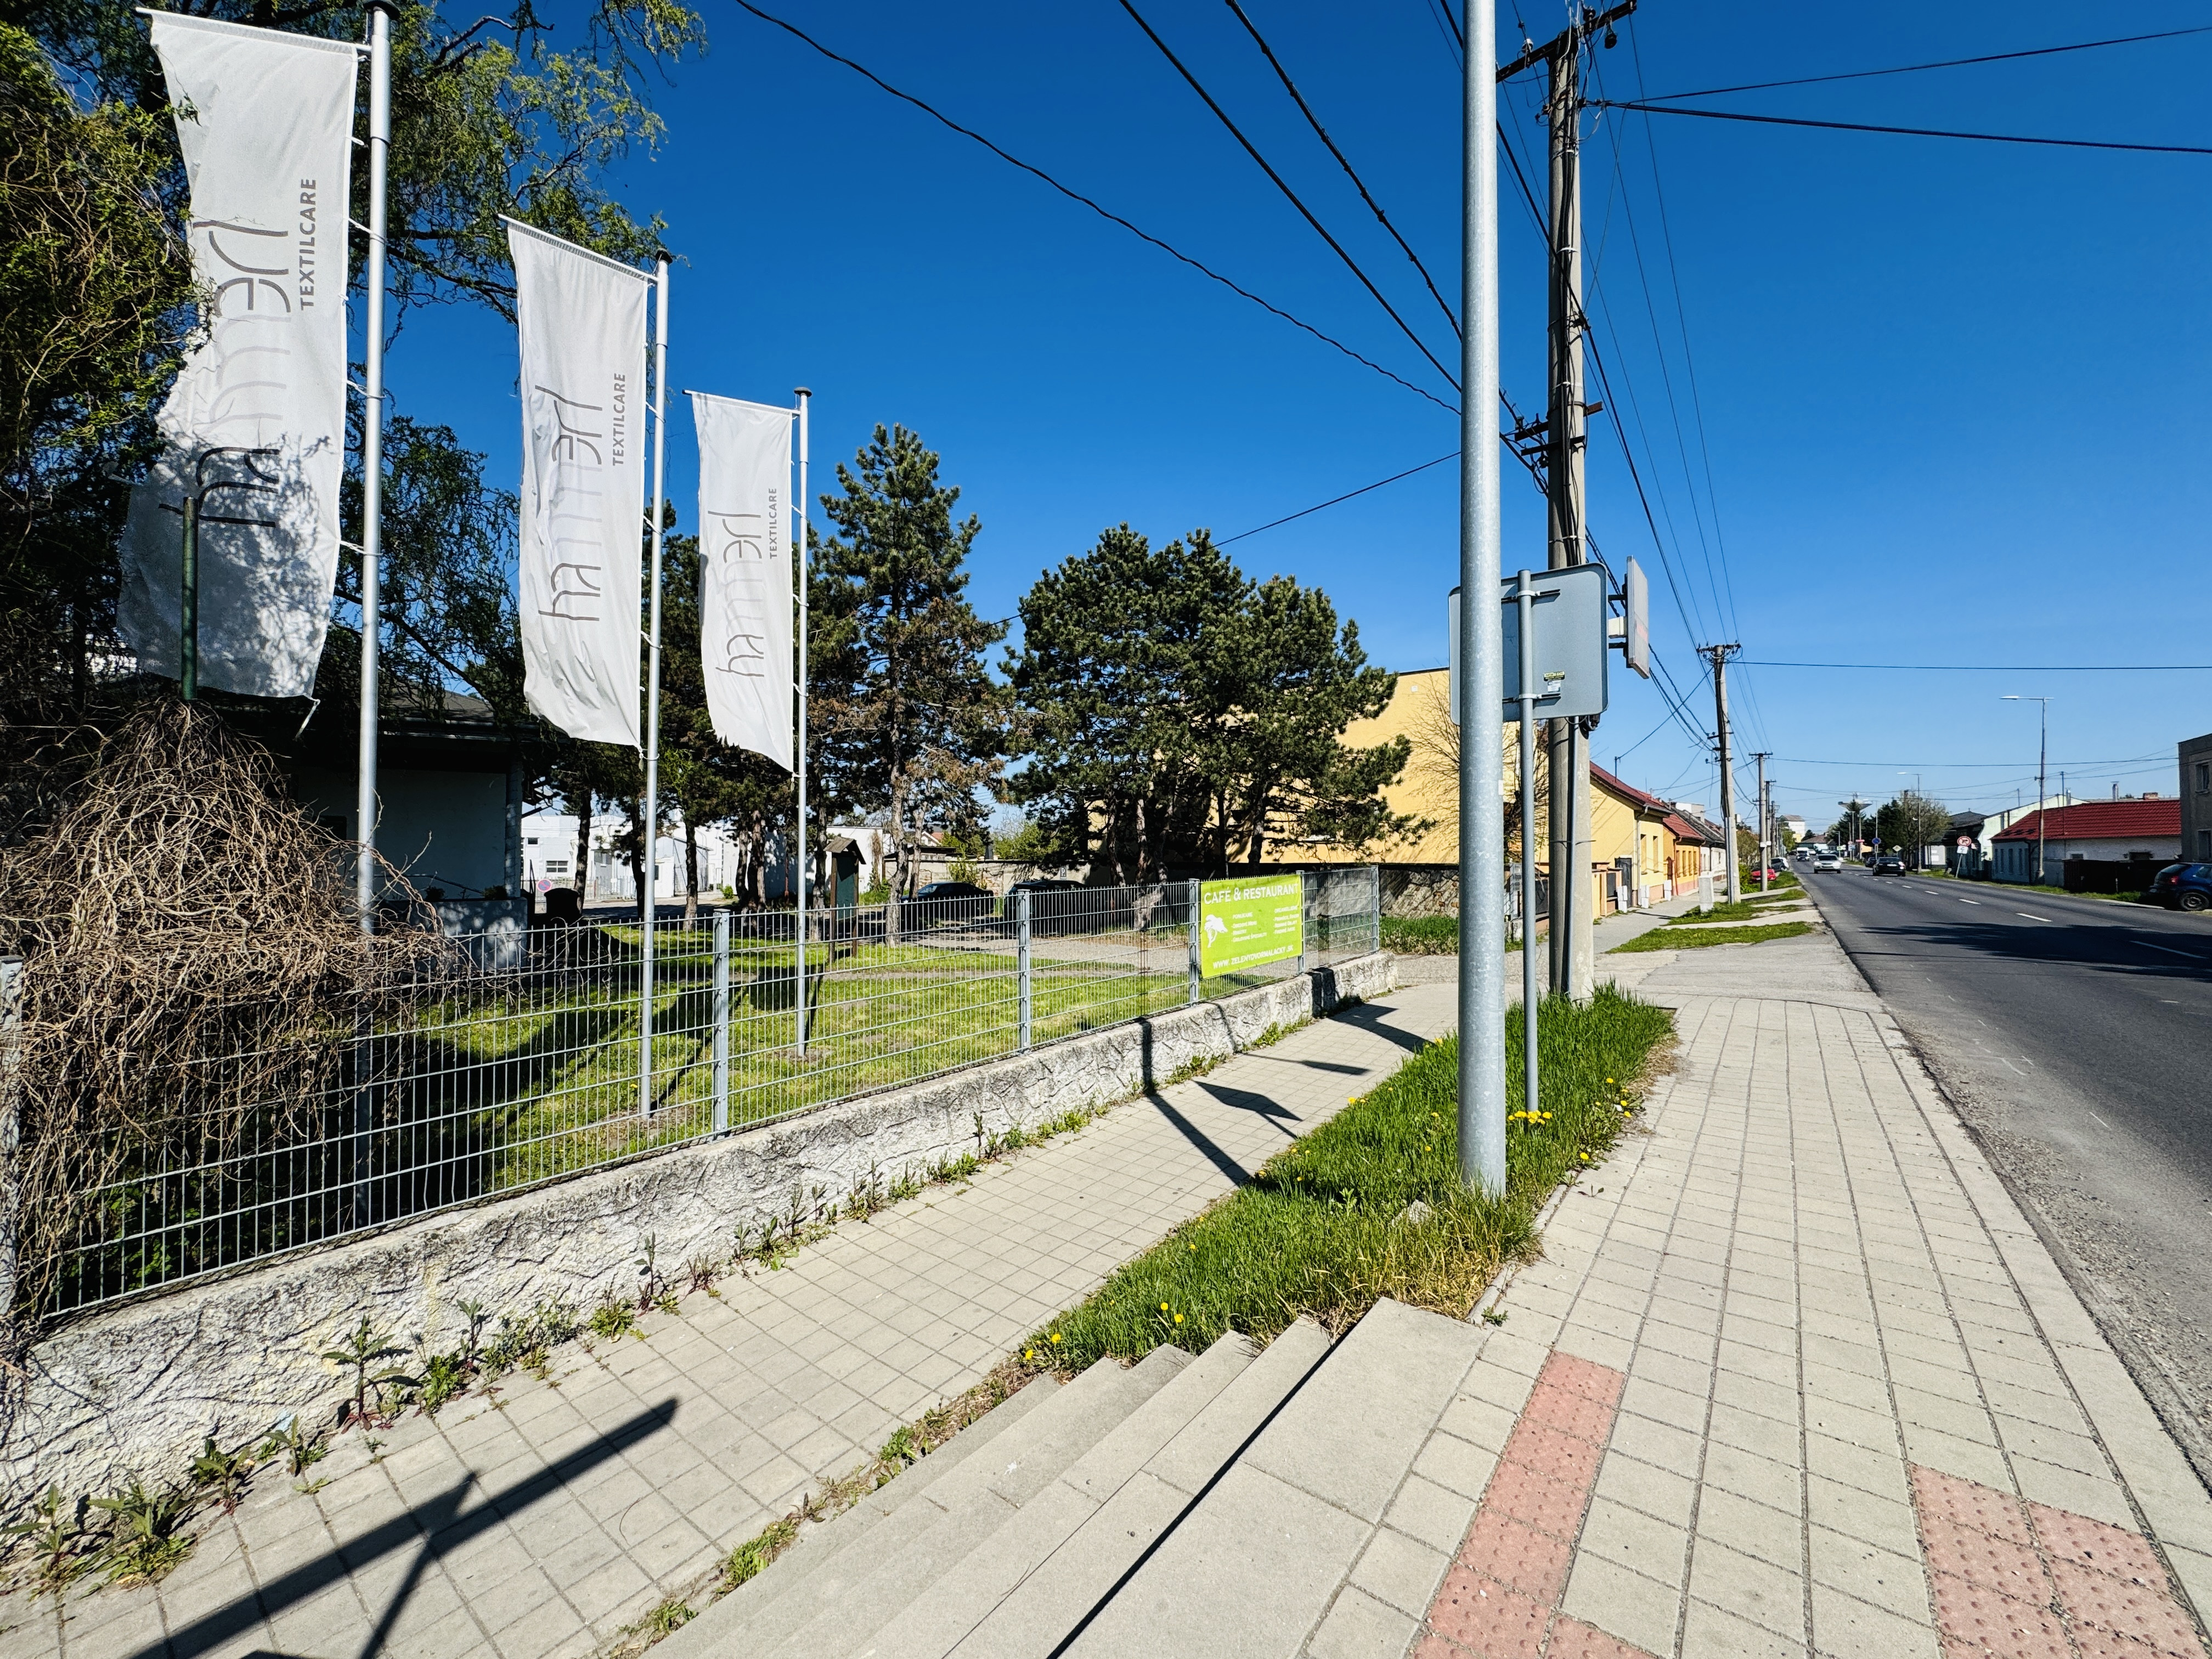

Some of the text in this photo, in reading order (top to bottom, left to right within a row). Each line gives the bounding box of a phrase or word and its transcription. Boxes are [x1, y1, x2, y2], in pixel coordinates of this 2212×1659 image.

[300, 178, 317, 311] TEXTILCARE
[612, 373, 627, 466] TEXTILCARE
[768, 487, 778, 560] TEXTILCARE
[1204, 883, 1298, 905] CAFÉ & RESTAURANT
